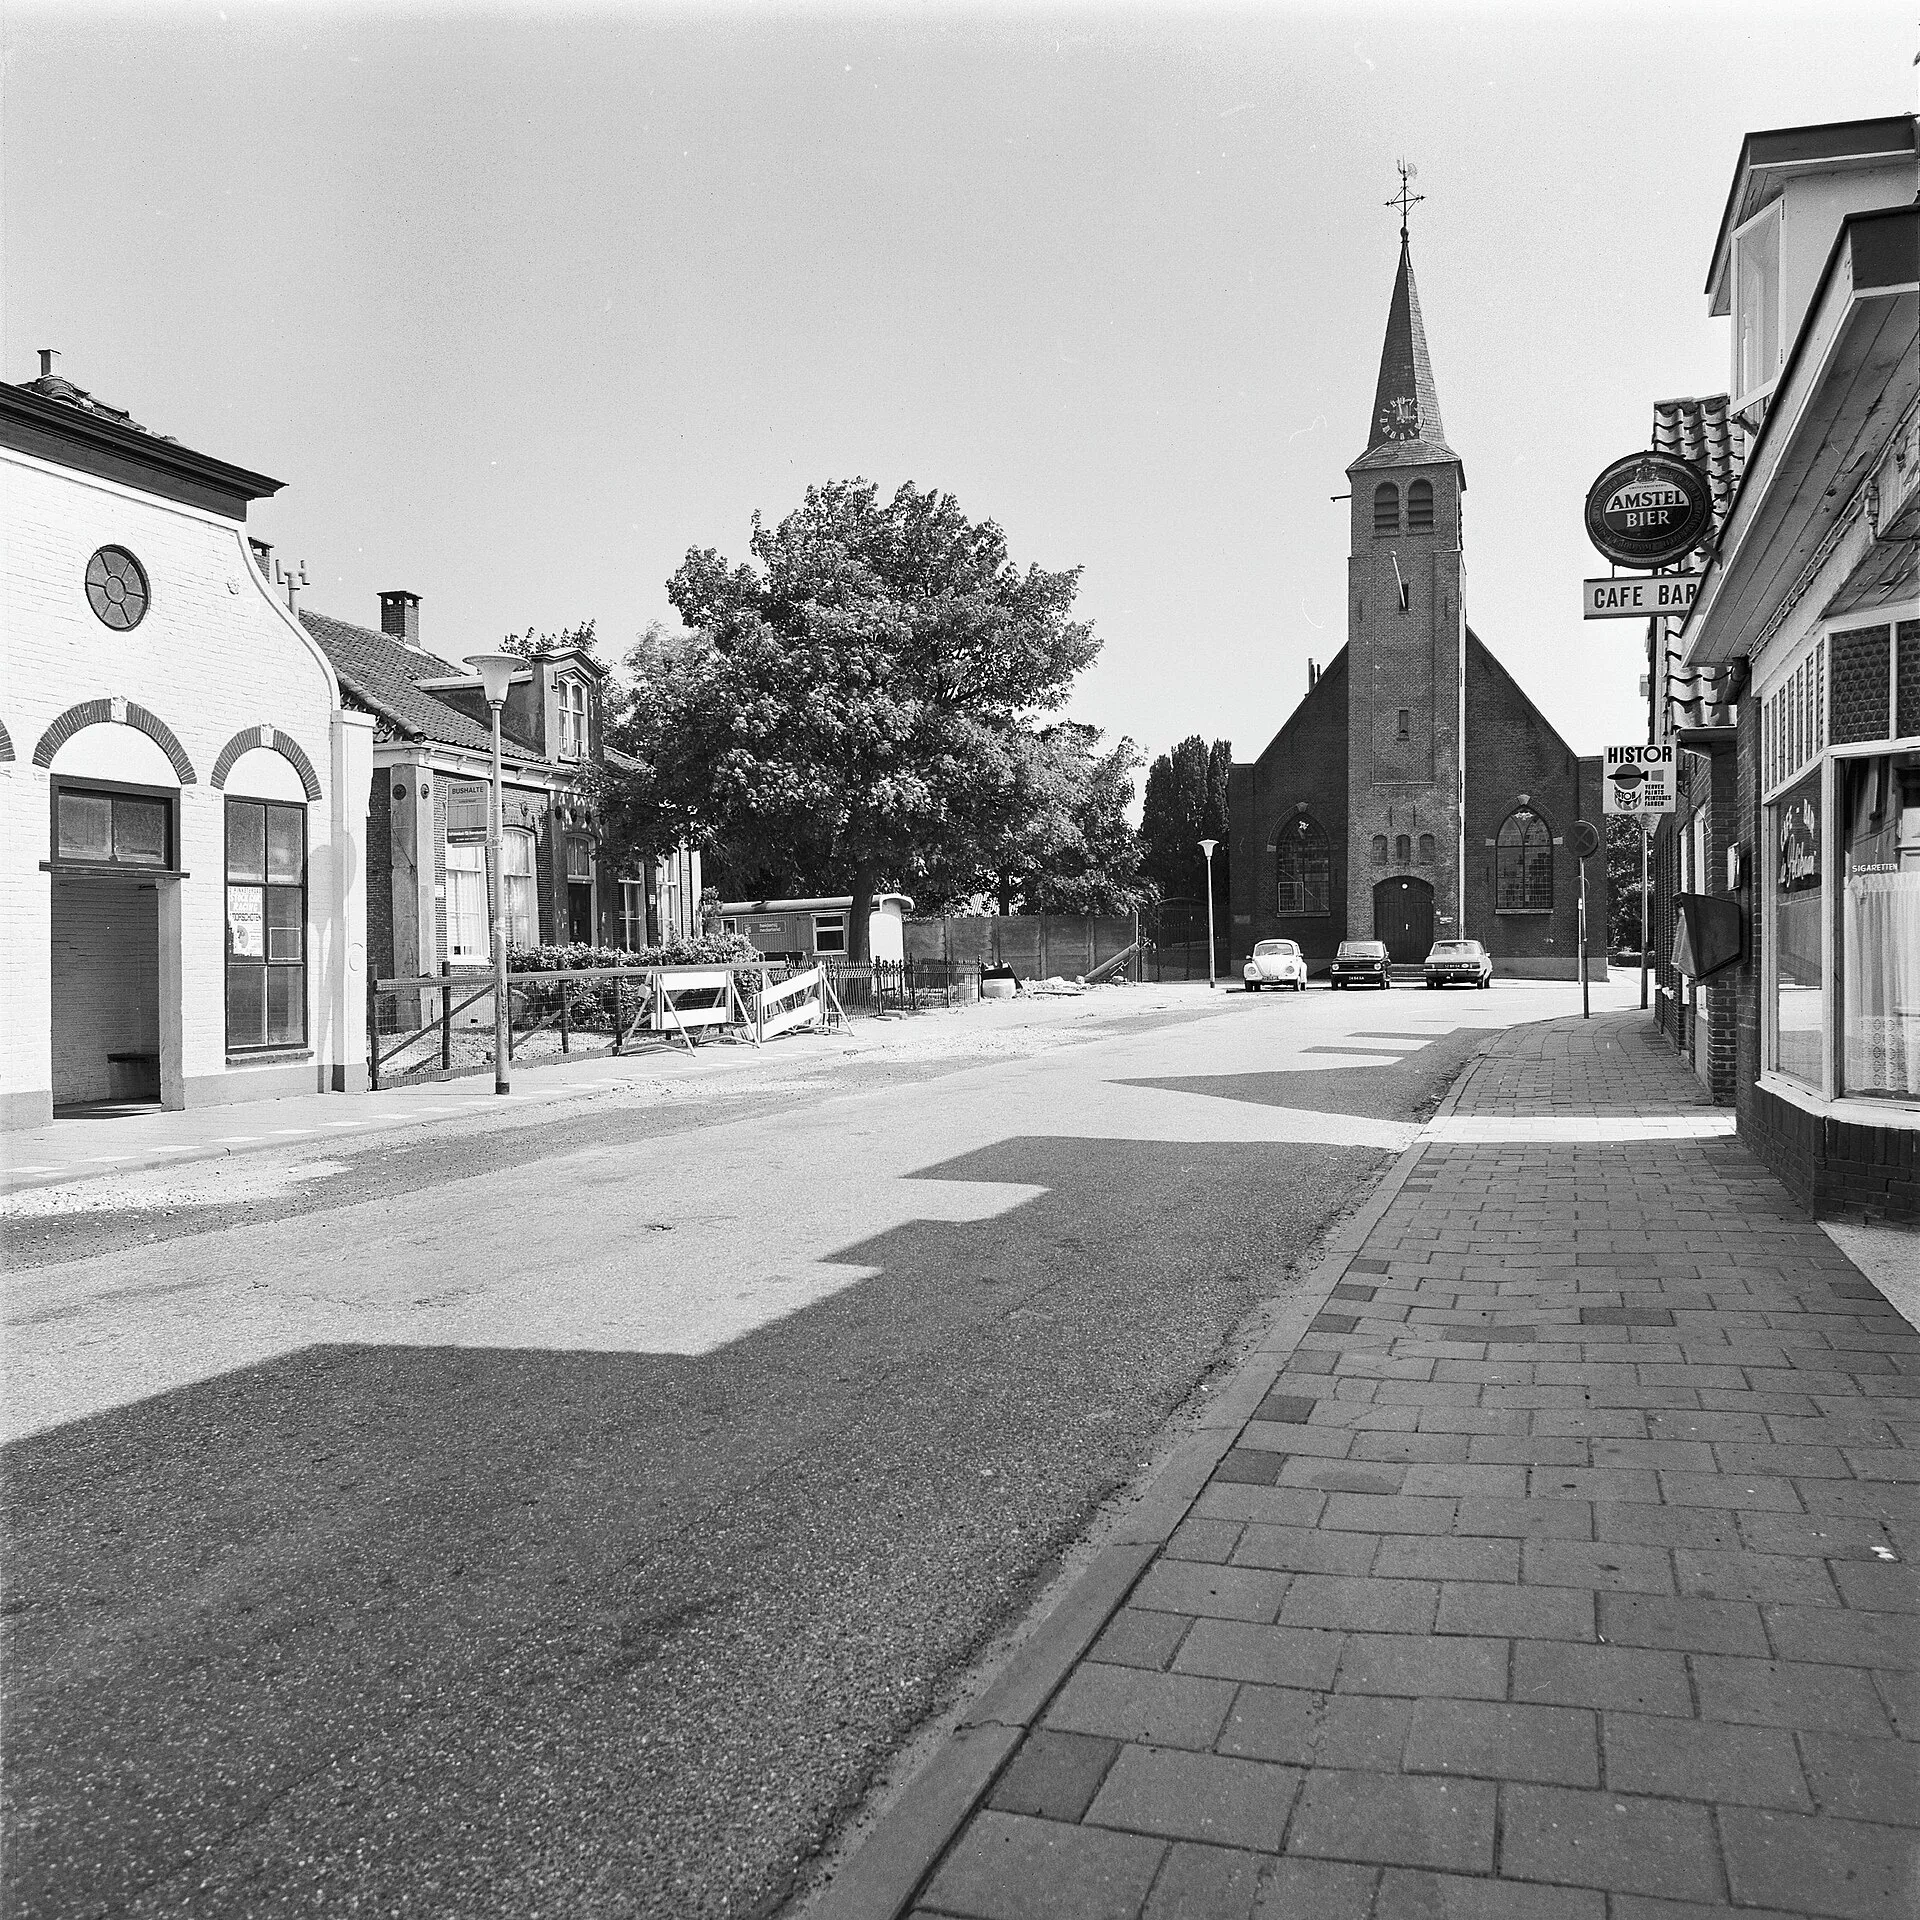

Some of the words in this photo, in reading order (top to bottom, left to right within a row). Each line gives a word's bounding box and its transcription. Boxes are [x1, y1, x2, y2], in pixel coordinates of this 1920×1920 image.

[1609, 489, 1685, 511] AMSTEL
[1626, 510, 1671, 528] BIER
[1594, 586, 1643, 609] CAFE
[1658, 583, 1698, 606] BAR
[1608, 746, 1672, 764] HISTOR
[452, 786, 484, 795] BUSHALTE
[1852, 863, 1898, 873] SIGARETTEN
